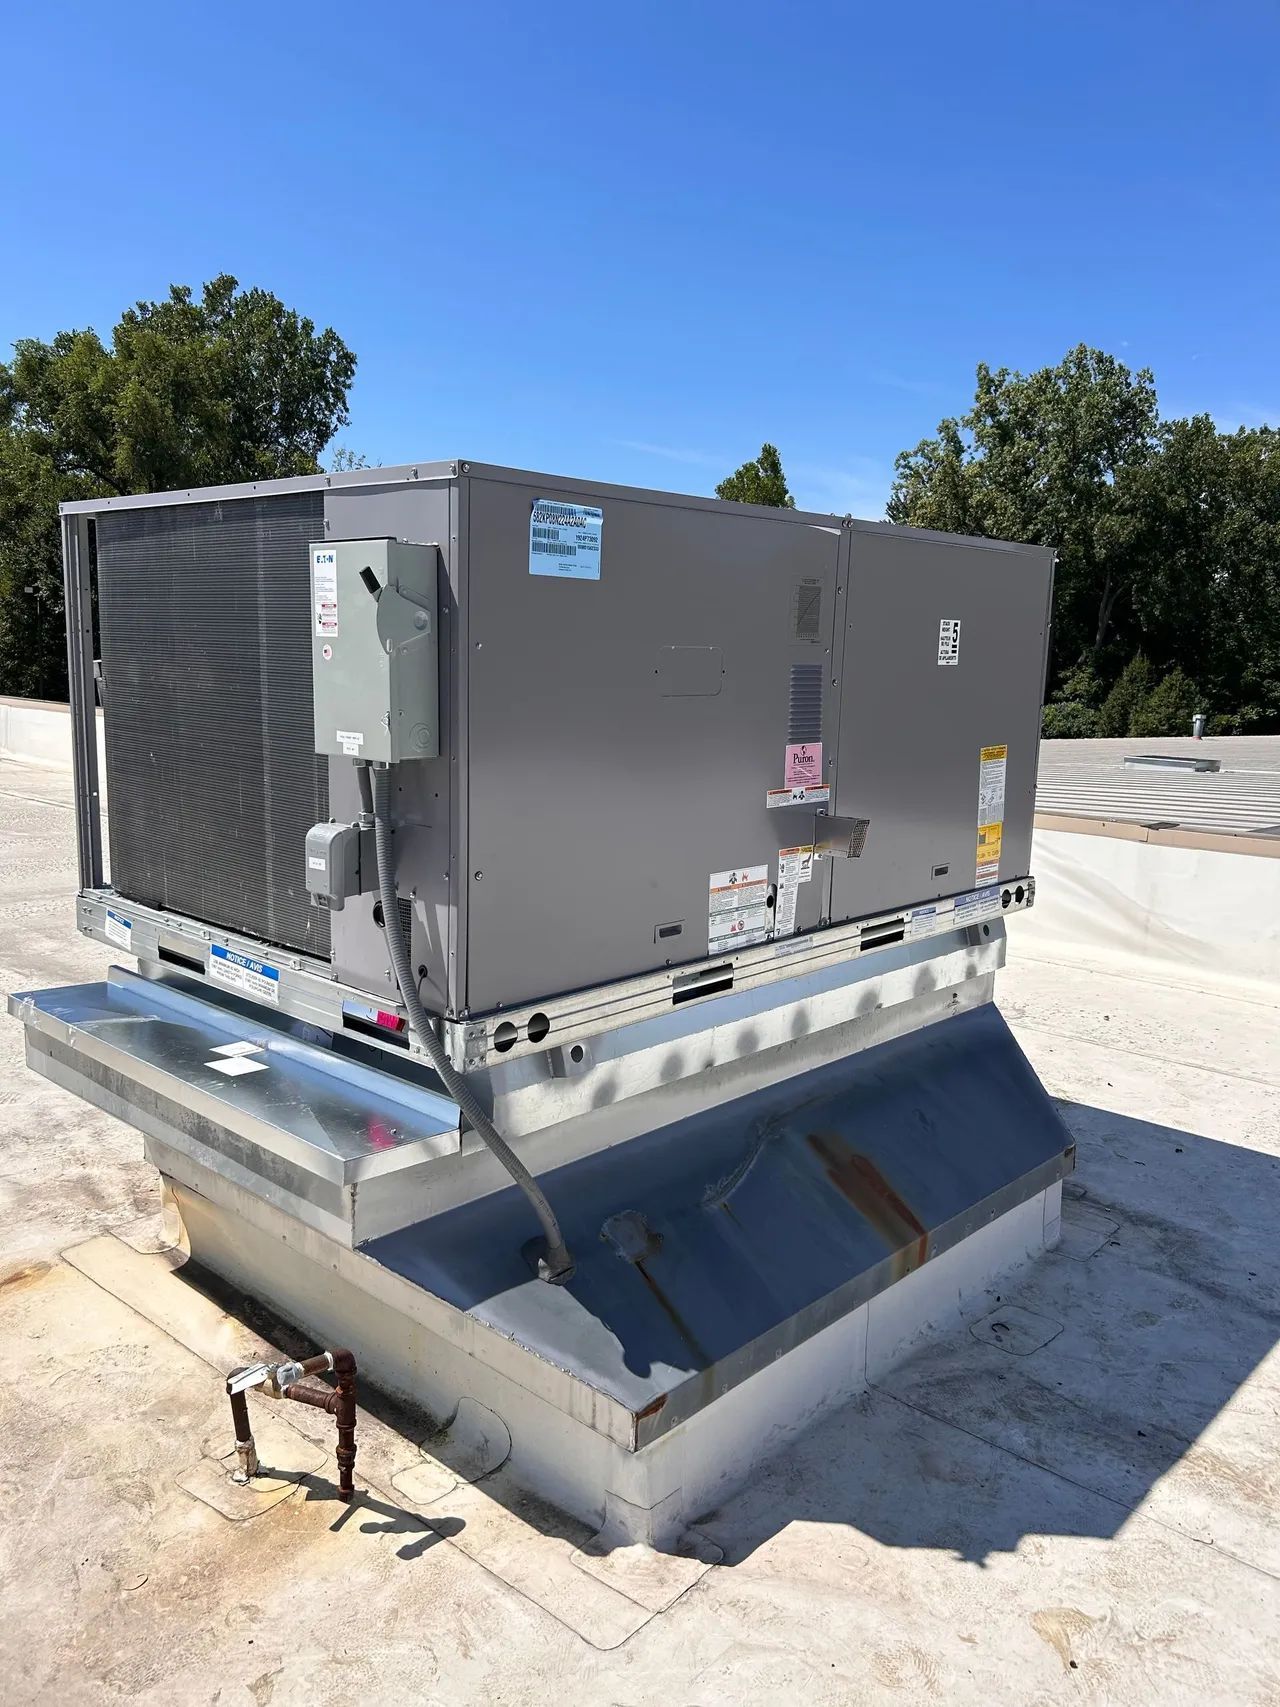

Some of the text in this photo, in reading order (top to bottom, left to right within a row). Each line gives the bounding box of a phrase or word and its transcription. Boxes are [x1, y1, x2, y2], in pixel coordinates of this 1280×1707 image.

[952, 622, 958, 643] 5
[226, 951, 246, 967] NOTICE
[250, 961, 263, 973] AVIS
